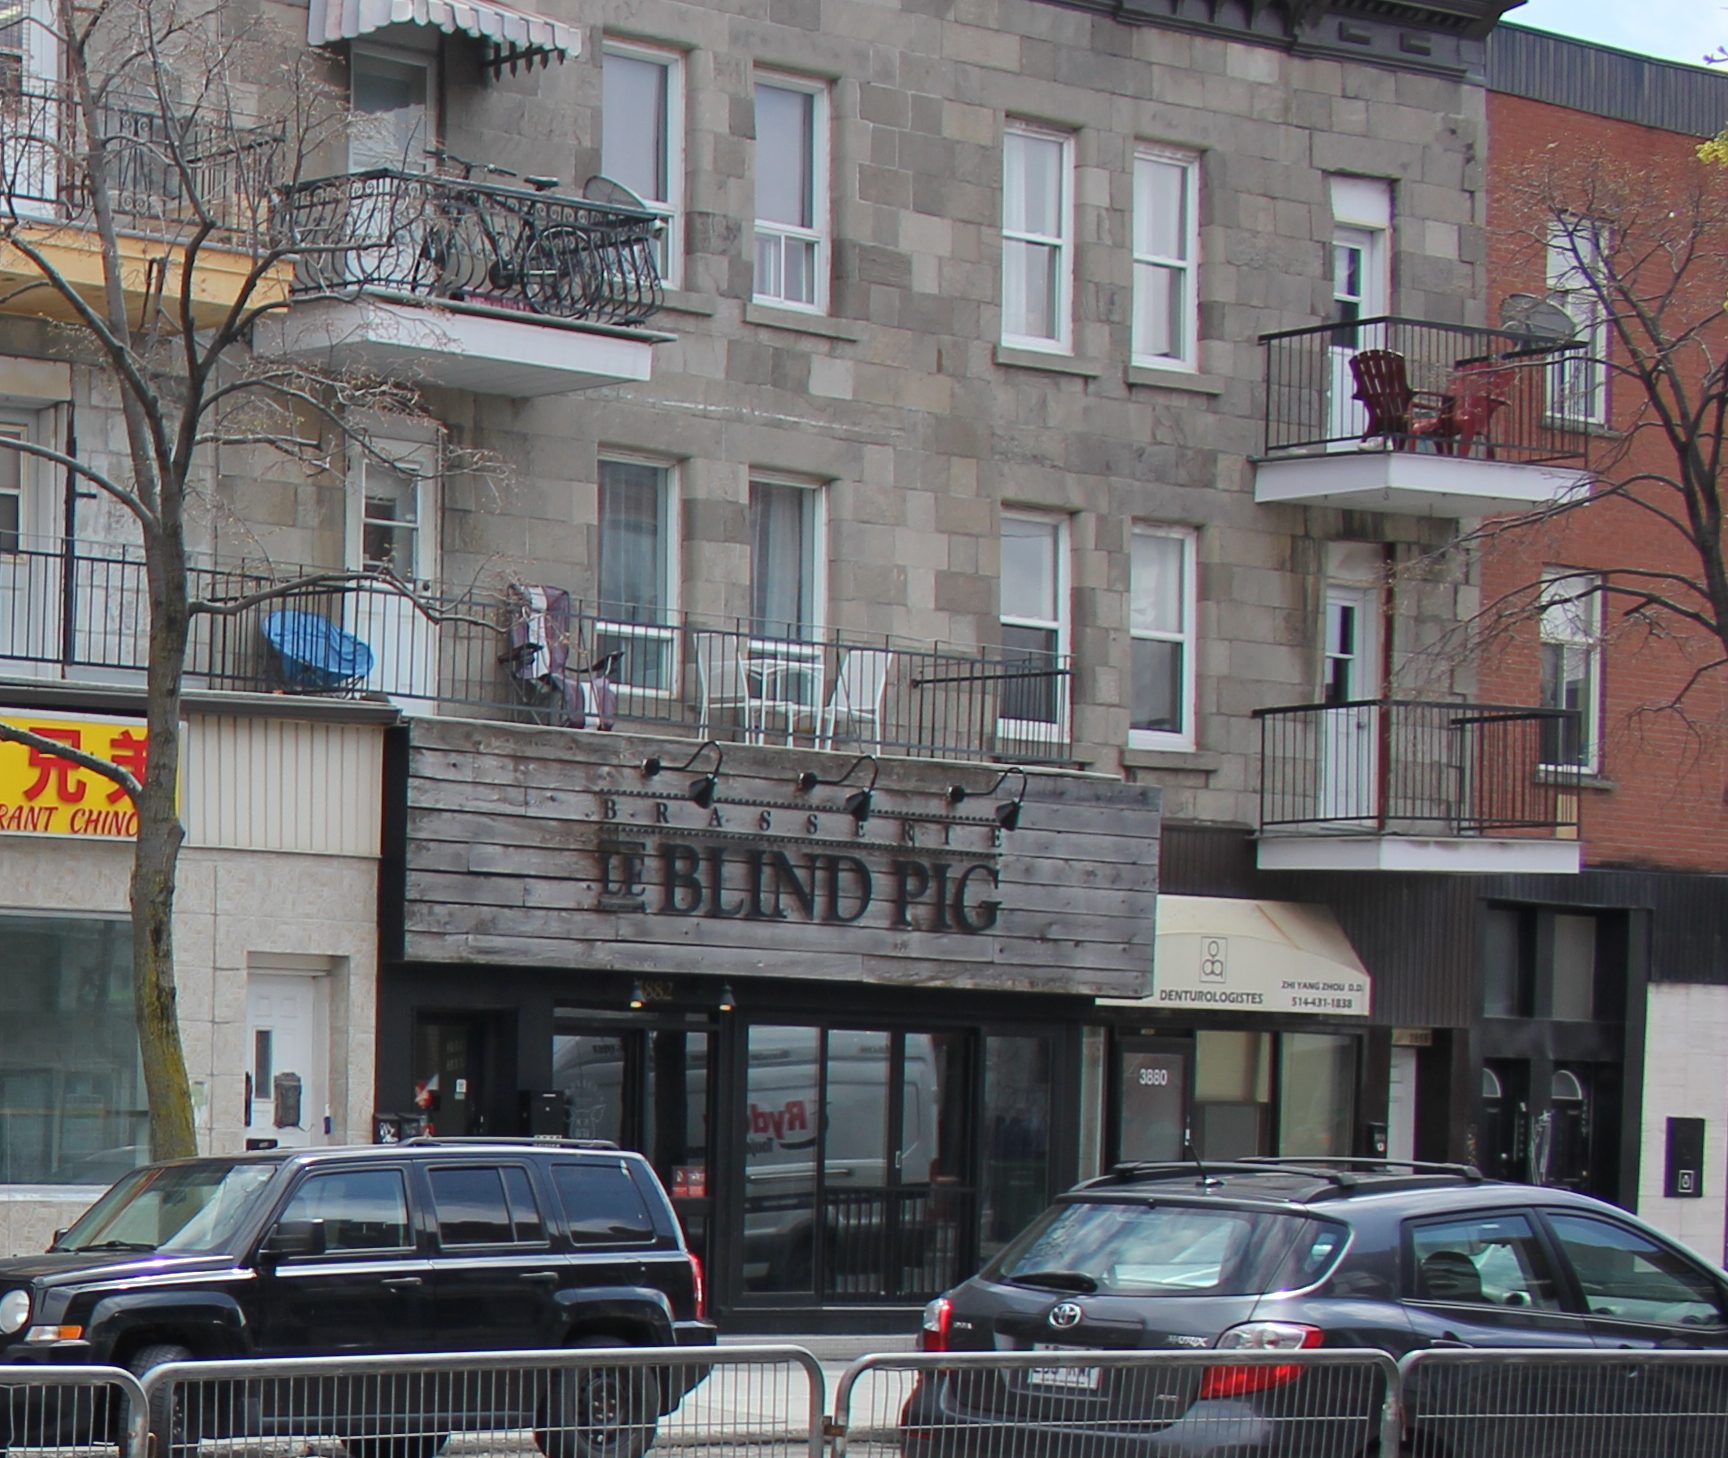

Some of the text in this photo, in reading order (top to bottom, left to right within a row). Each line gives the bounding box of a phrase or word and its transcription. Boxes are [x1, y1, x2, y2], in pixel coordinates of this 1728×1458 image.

[600, 842, 1004, 933] LE BLIND PIG
[1297, 981, 1320, 992] YANG
[1321, 981, 1346, 992] ZHOU
[1159, 988, 1264, 1006] DENTUROLOGISTES
[1139, 1068, 1168, 1086] 3880
